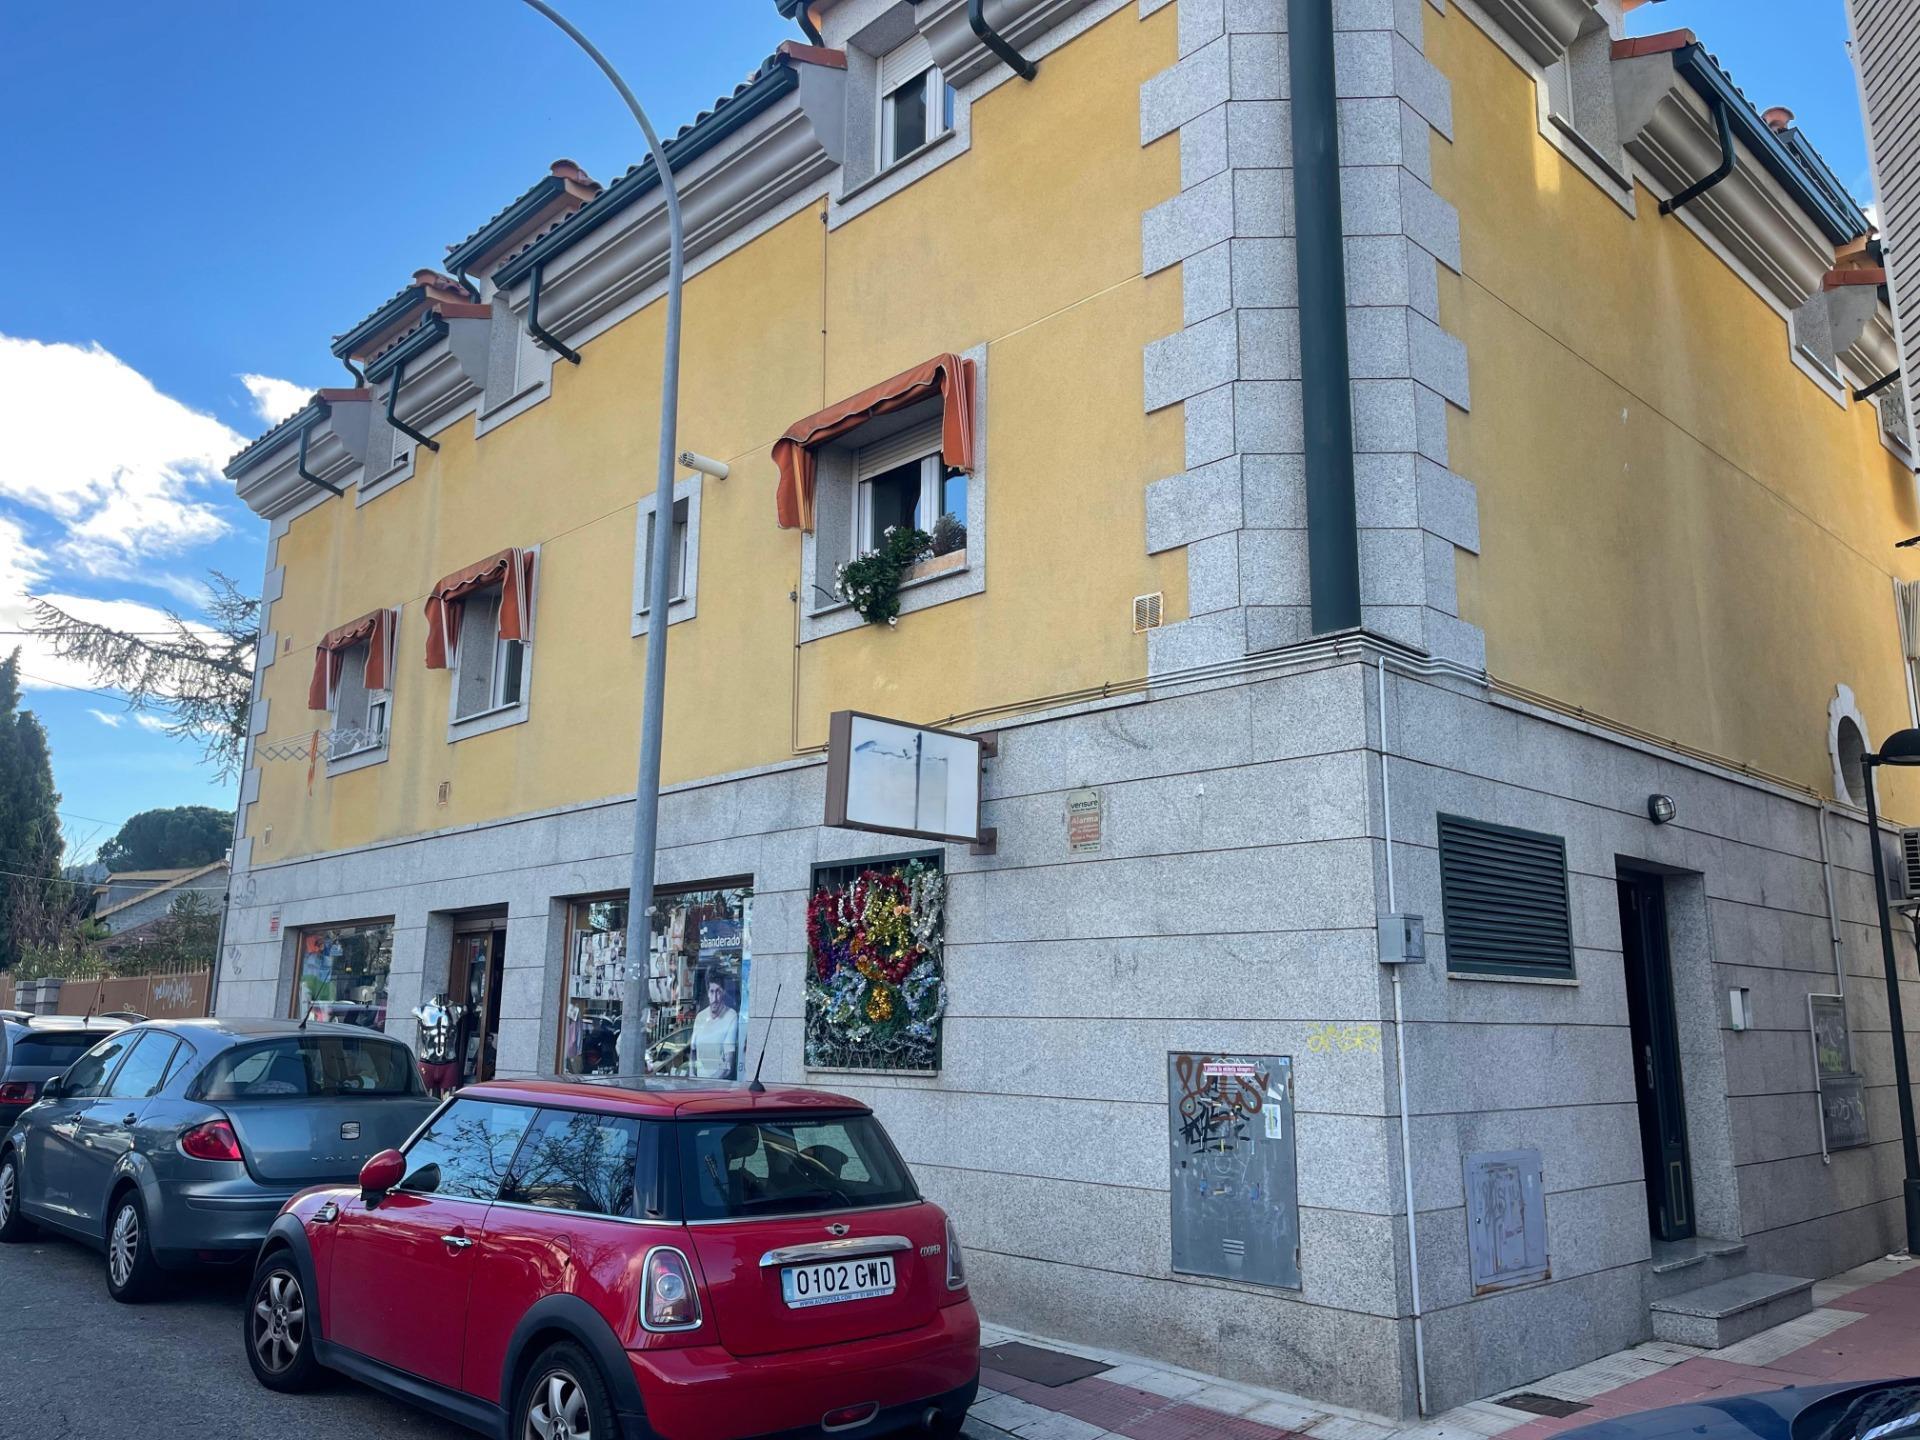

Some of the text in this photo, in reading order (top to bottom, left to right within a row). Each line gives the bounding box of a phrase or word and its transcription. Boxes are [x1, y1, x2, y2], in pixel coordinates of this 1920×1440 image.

[700, 934, 741, 948] abanderado
[920, 1244, 940, 1257] COOPER
[797, 1262, 891, 1295] 0102 GWD
